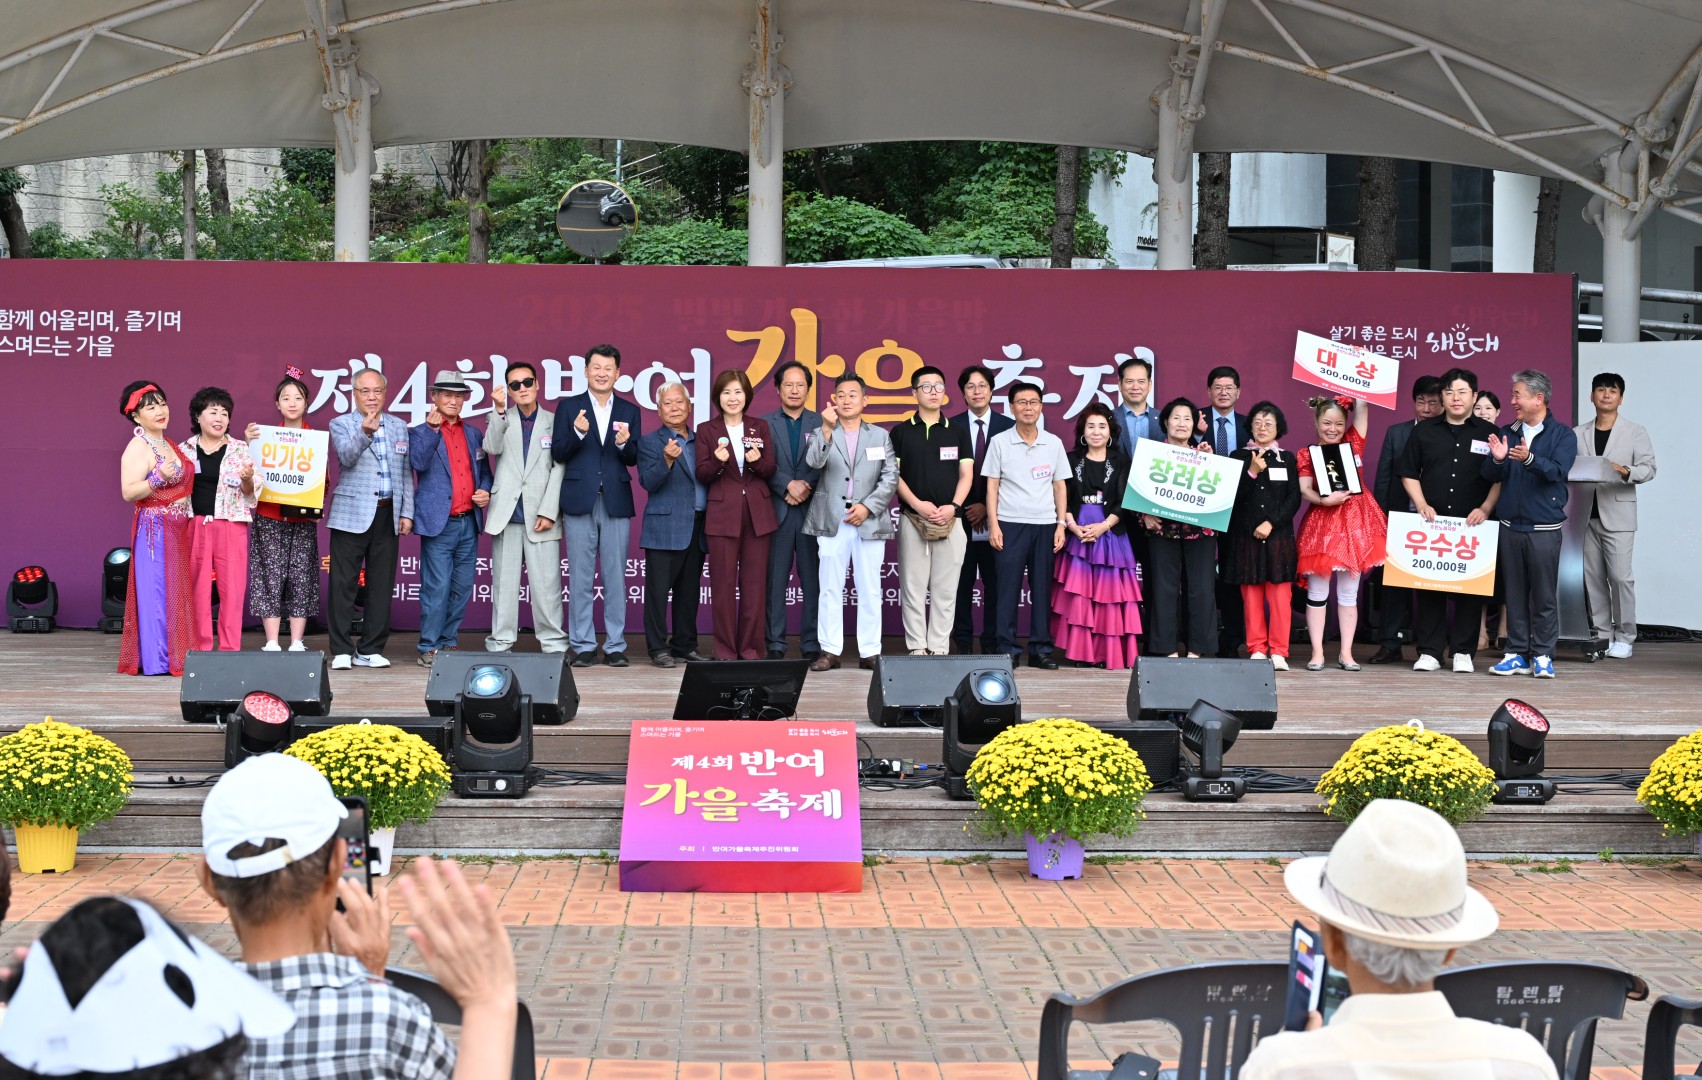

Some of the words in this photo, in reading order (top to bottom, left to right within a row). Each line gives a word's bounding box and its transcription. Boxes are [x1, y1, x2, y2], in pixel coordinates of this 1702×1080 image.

[0, 309, 34, 331] 함께
[39, 309, 120, 333] 어울리며,
[125, 310, 182, 332] 즐기며
[0, 335, 72, 357] 스며드는
[76, 335, 115, 357] 가을
[1329, 325, 1356, 341] 살기
[1360, 325, 1387, 341] 좋은
[1391, 327, 1418, 341] 도시
[1425, 326, 1500, 360] 해운대
[1391, 346, 1418, 360] 도시
[726, 307, 949, 423] 가을
[1316, 348, 1338, 369] 대
[1355, 361, 1378, 380] 상
[261, 441, 315, 472] 인기상
[266, 472, 305, 486] 100,000원
[1148, 457, 1222, 495] 장려상
[1154, 486, 1206, 507] 100,000원
[1405, 530, 1480, 561] 우수상
[1412, 559, 1467, 574] 200,000원
[671, 754, 733, 771] 제4회
[739, 748, 825, 777] 반여
[639, 778, 749, 822] 가을
[750, 787, 843, 820] 축제
